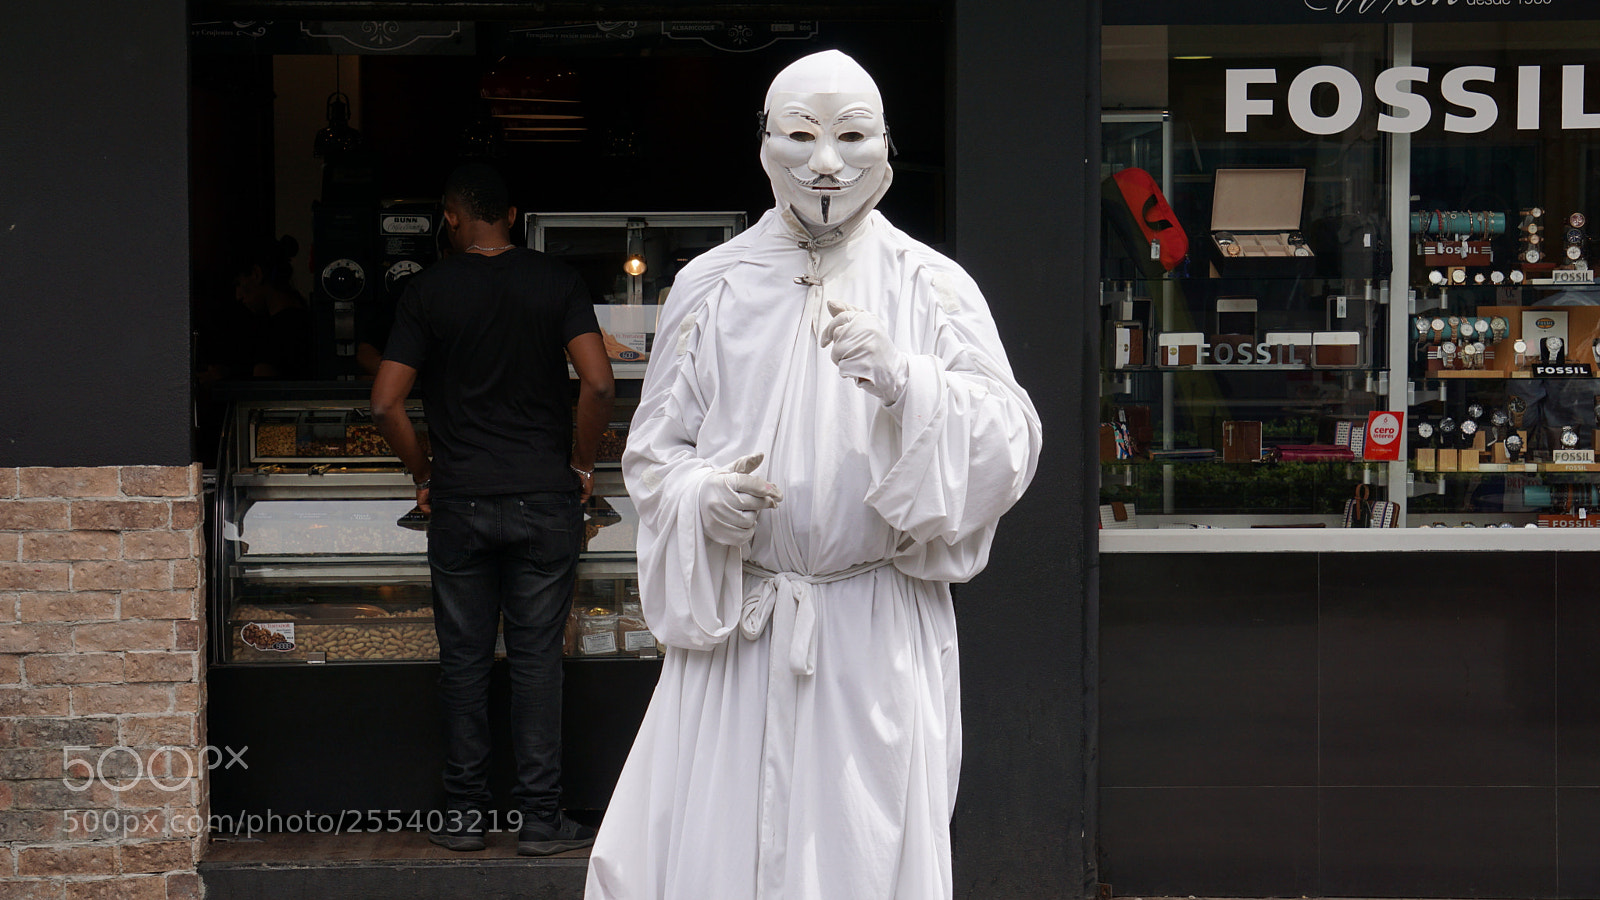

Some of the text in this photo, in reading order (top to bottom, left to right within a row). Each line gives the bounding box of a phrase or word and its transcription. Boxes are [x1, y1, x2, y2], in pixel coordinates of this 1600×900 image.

[1225, 65, 1600, 135] FOSSIL
[1442, 246, 1479, 254] OSIL
[1554, 271, 1591, 282] FOSSIL
[1196, 342, 1303, 365] FOSSIL
[1537, 366, 1589, 375] FOSSIL
[1555, 452, 1592, 461] FOSSIL
[1553, 520, 1594, 528] FOSSIL
